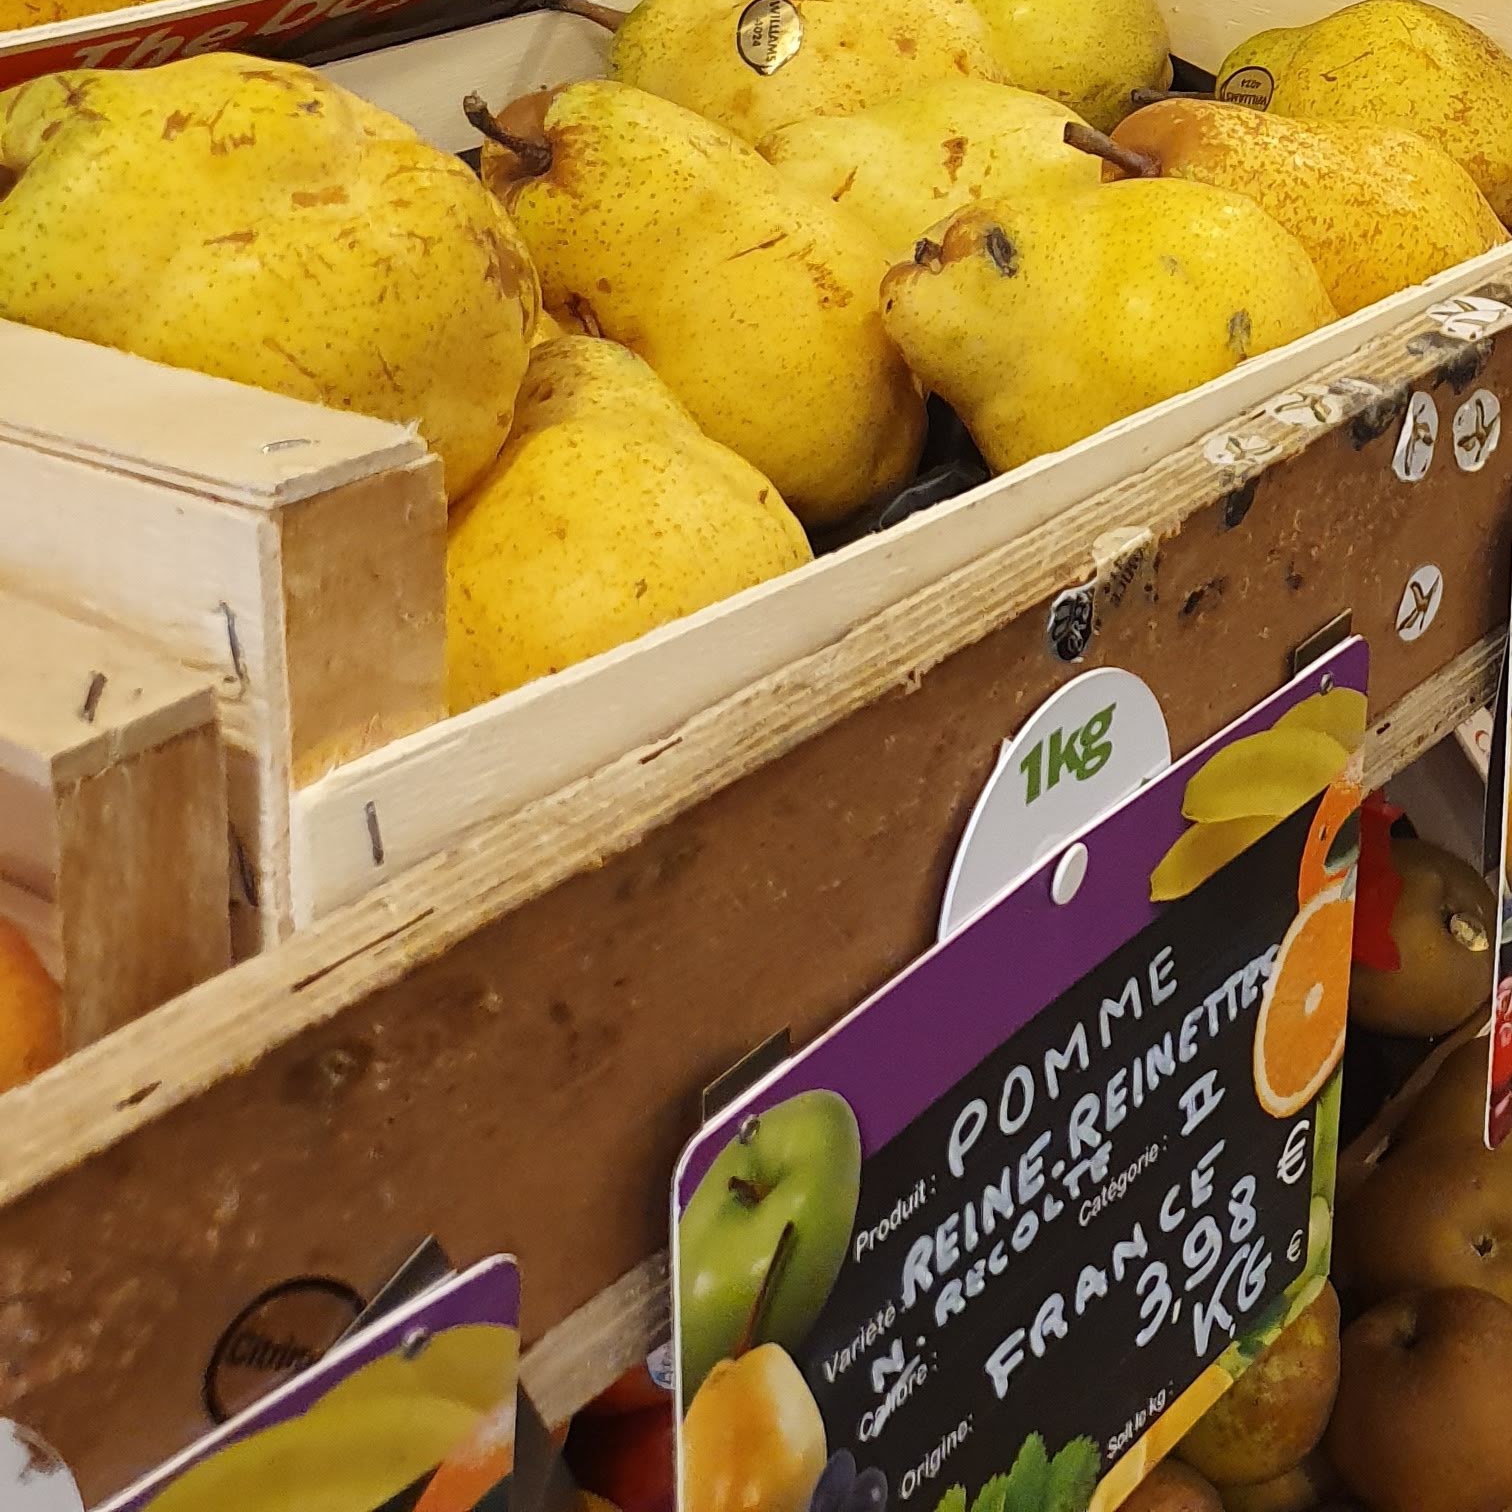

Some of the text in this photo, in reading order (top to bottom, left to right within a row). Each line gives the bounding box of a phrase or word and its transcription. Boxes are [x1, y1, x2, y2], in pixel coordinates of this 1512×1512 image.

[74, 21, 249, 70] The
[765, 0, 781, 63] WILLIAMS
[1019, 700, 1117, 808] 1kg
[947, 944, 1179, 1179] POMME
[933, 1138, 1115, 1327] RECOLTE
[984, 1138, 1226, 1399] FRANCE
[1192, 1235, 1273, 1357] KG
